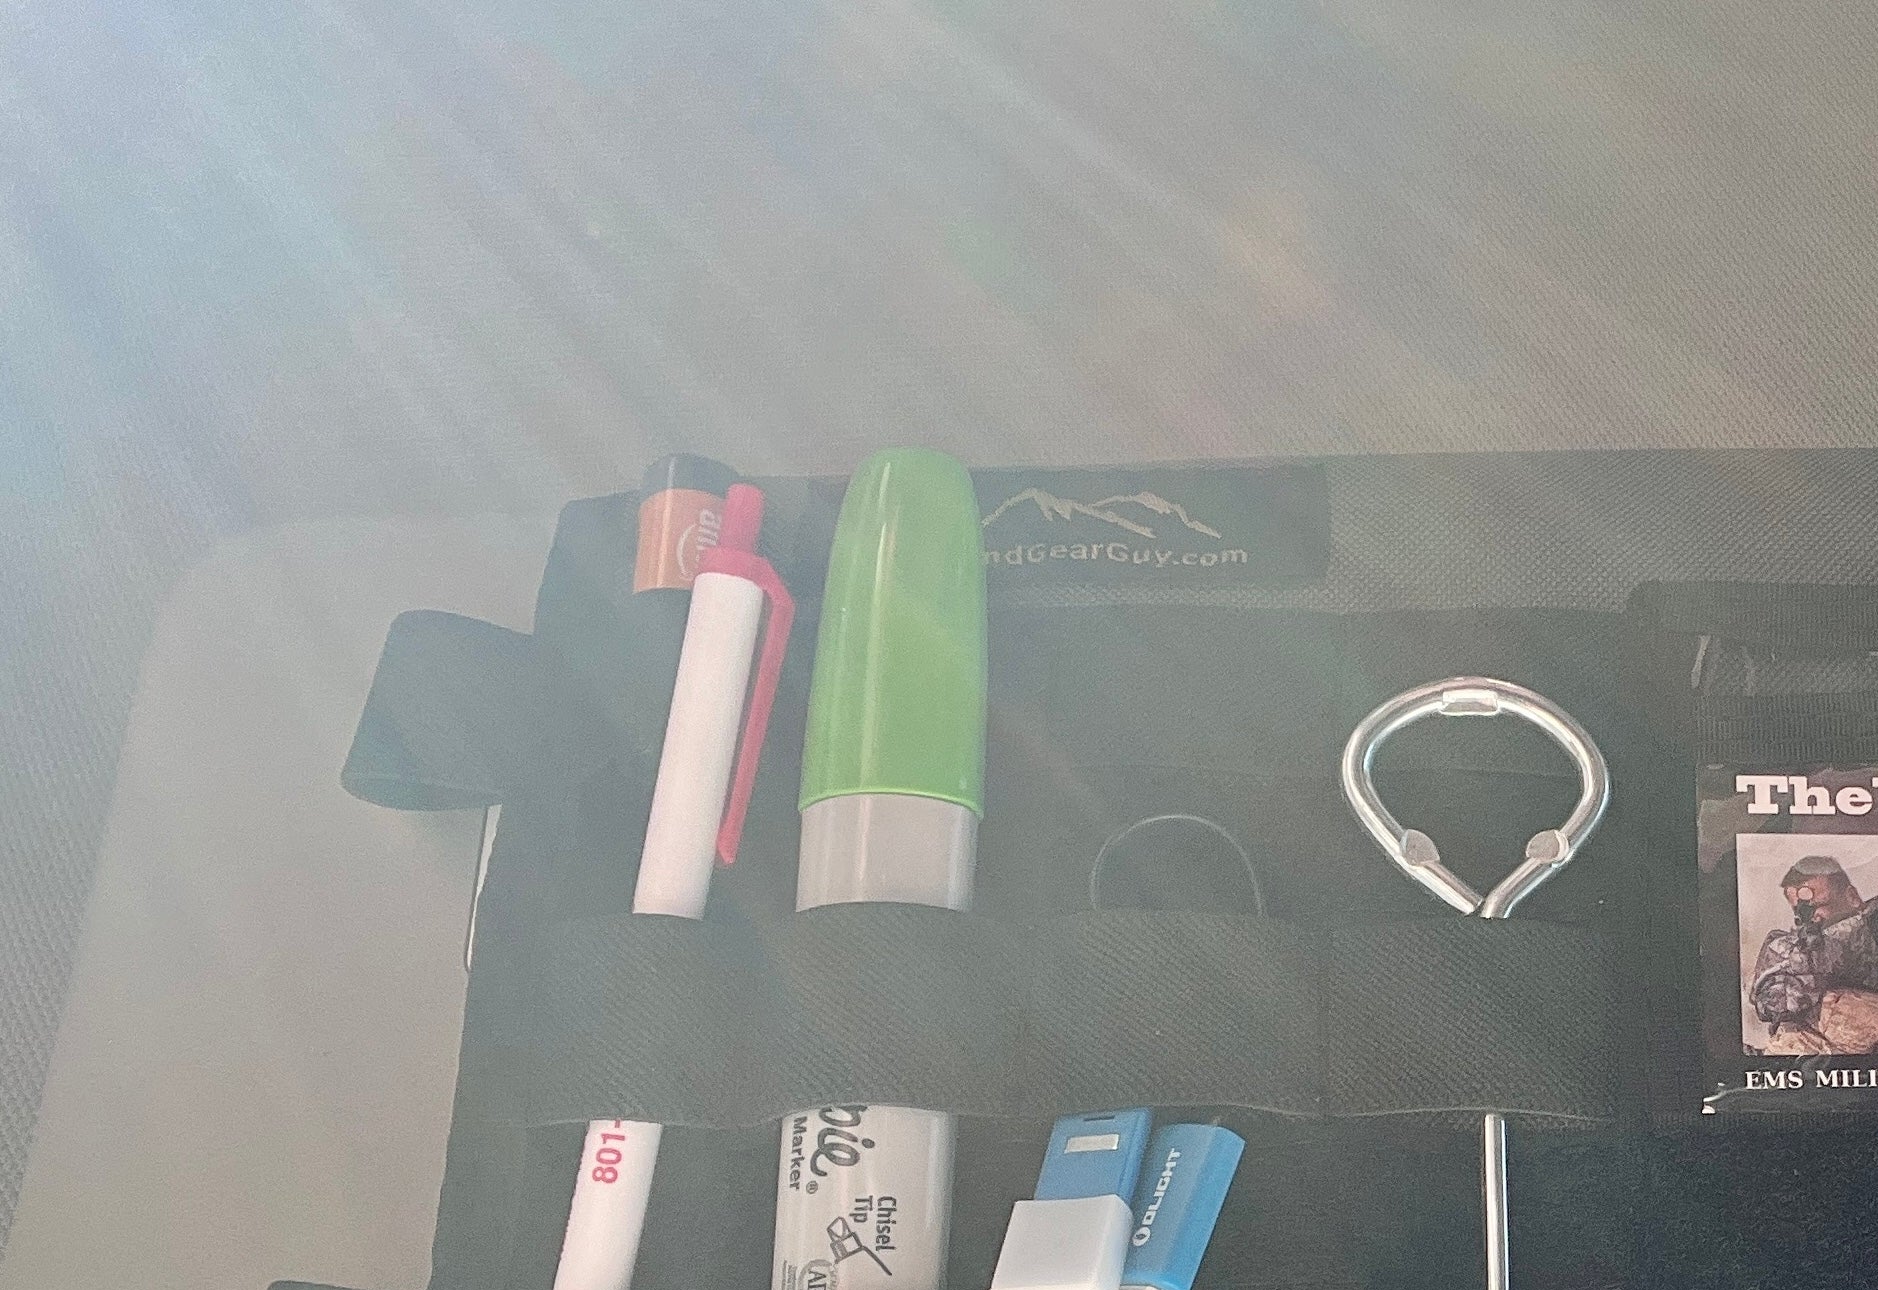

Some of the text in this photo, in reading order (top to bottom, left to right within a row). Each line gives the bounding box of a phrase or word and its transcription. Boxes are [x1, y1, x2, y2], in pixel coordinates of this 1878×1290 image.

[1745, 1070, 1803, 1090] EMS
[789, 1117, 809, 1191] Marker
[850, 1195, 874, 1224] Tip
[875, 1195, 898, 1253] Chisel
